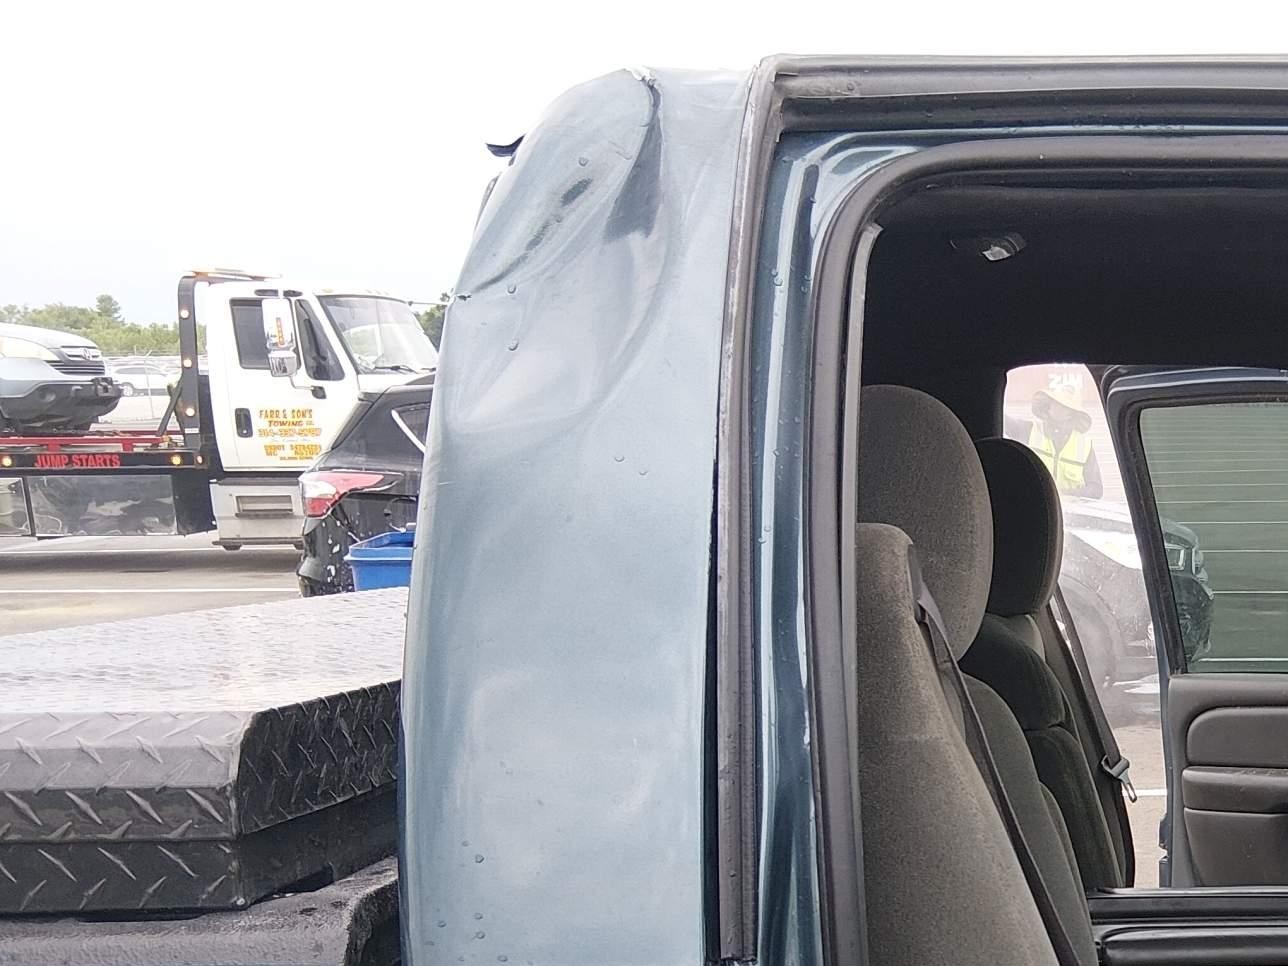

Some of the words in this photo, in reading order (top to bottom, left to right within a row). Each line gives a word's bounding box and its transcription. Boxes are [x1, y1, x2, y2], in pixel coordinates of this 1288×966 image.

[259, 409, 280, 419] FARR
[34, 454, 69, 470] JUMP
[71, 454, 121, 469] STARTS
